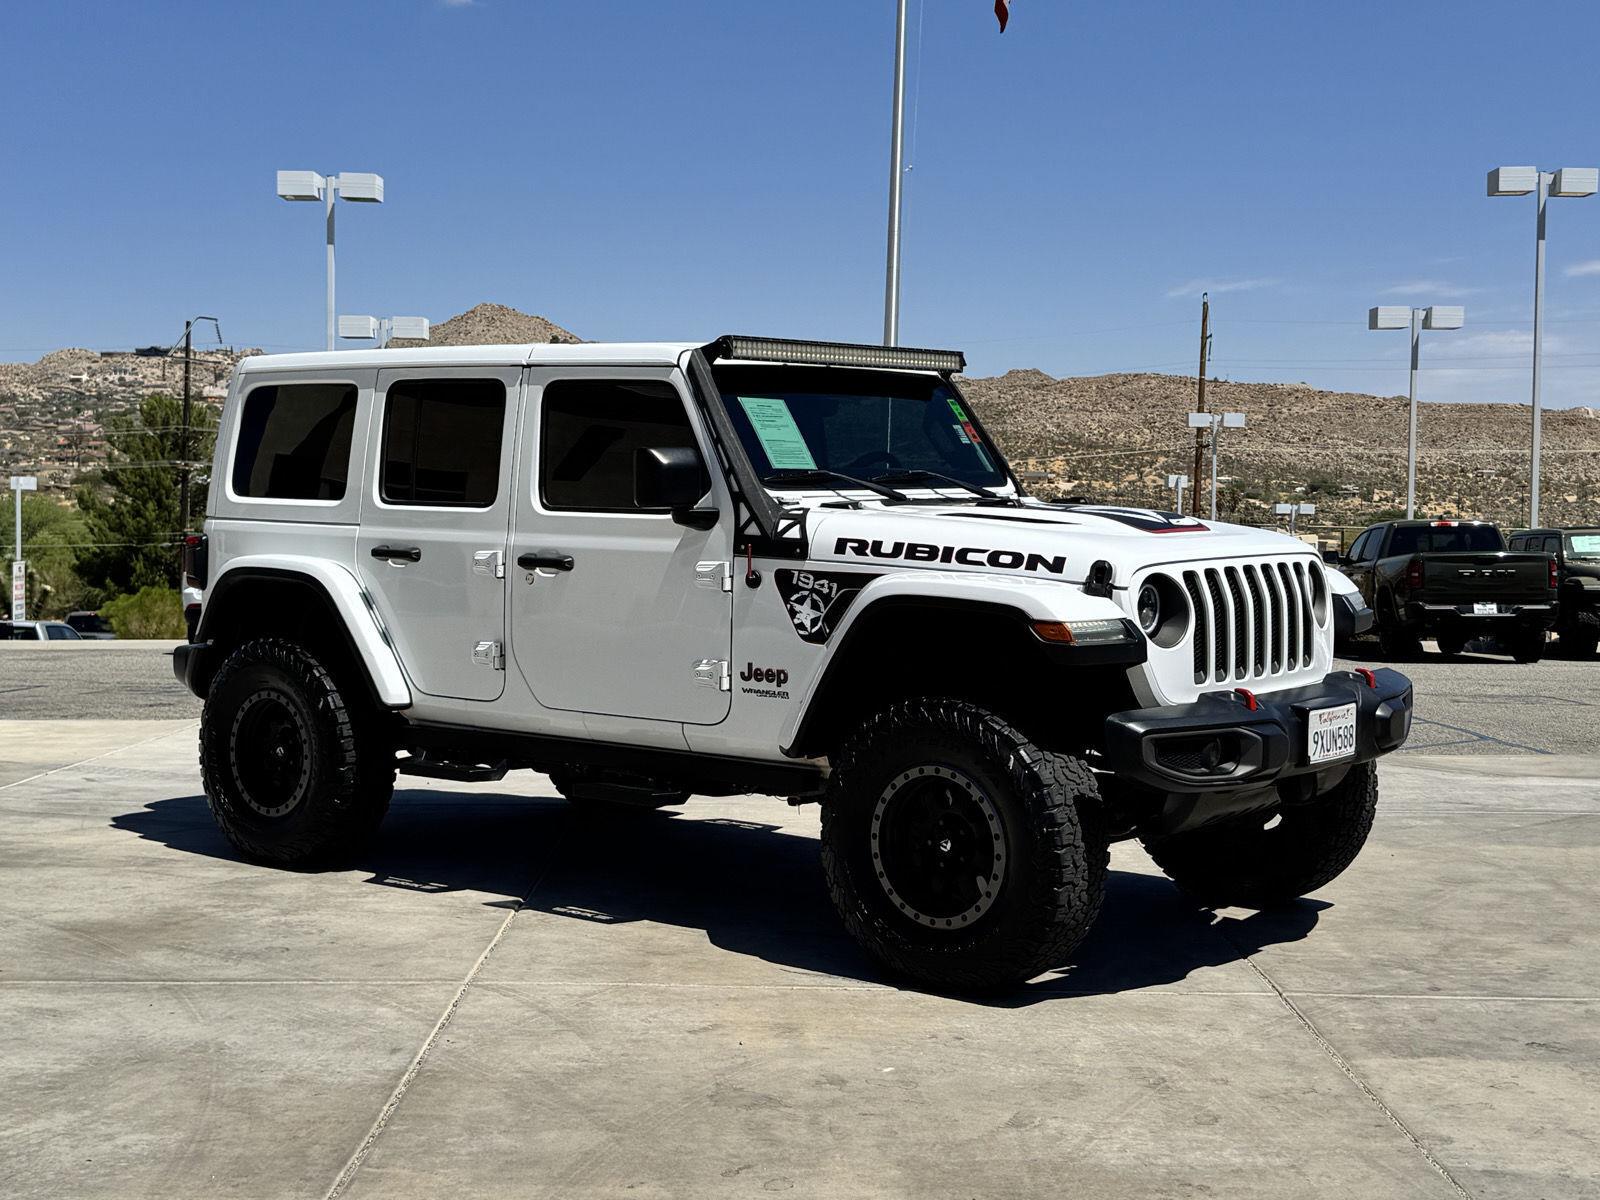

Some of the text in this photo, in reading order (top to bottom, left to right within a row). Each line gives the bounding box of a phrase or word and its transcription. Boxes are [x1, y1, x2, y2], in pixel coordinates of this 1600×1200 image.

[834, 537, 1067, 574] RUBICON
[791, 570, 838, 598] 1941
[740, 662, 789, 687] Jeep
[1312, 724, 1354, 758] 9XUN588
